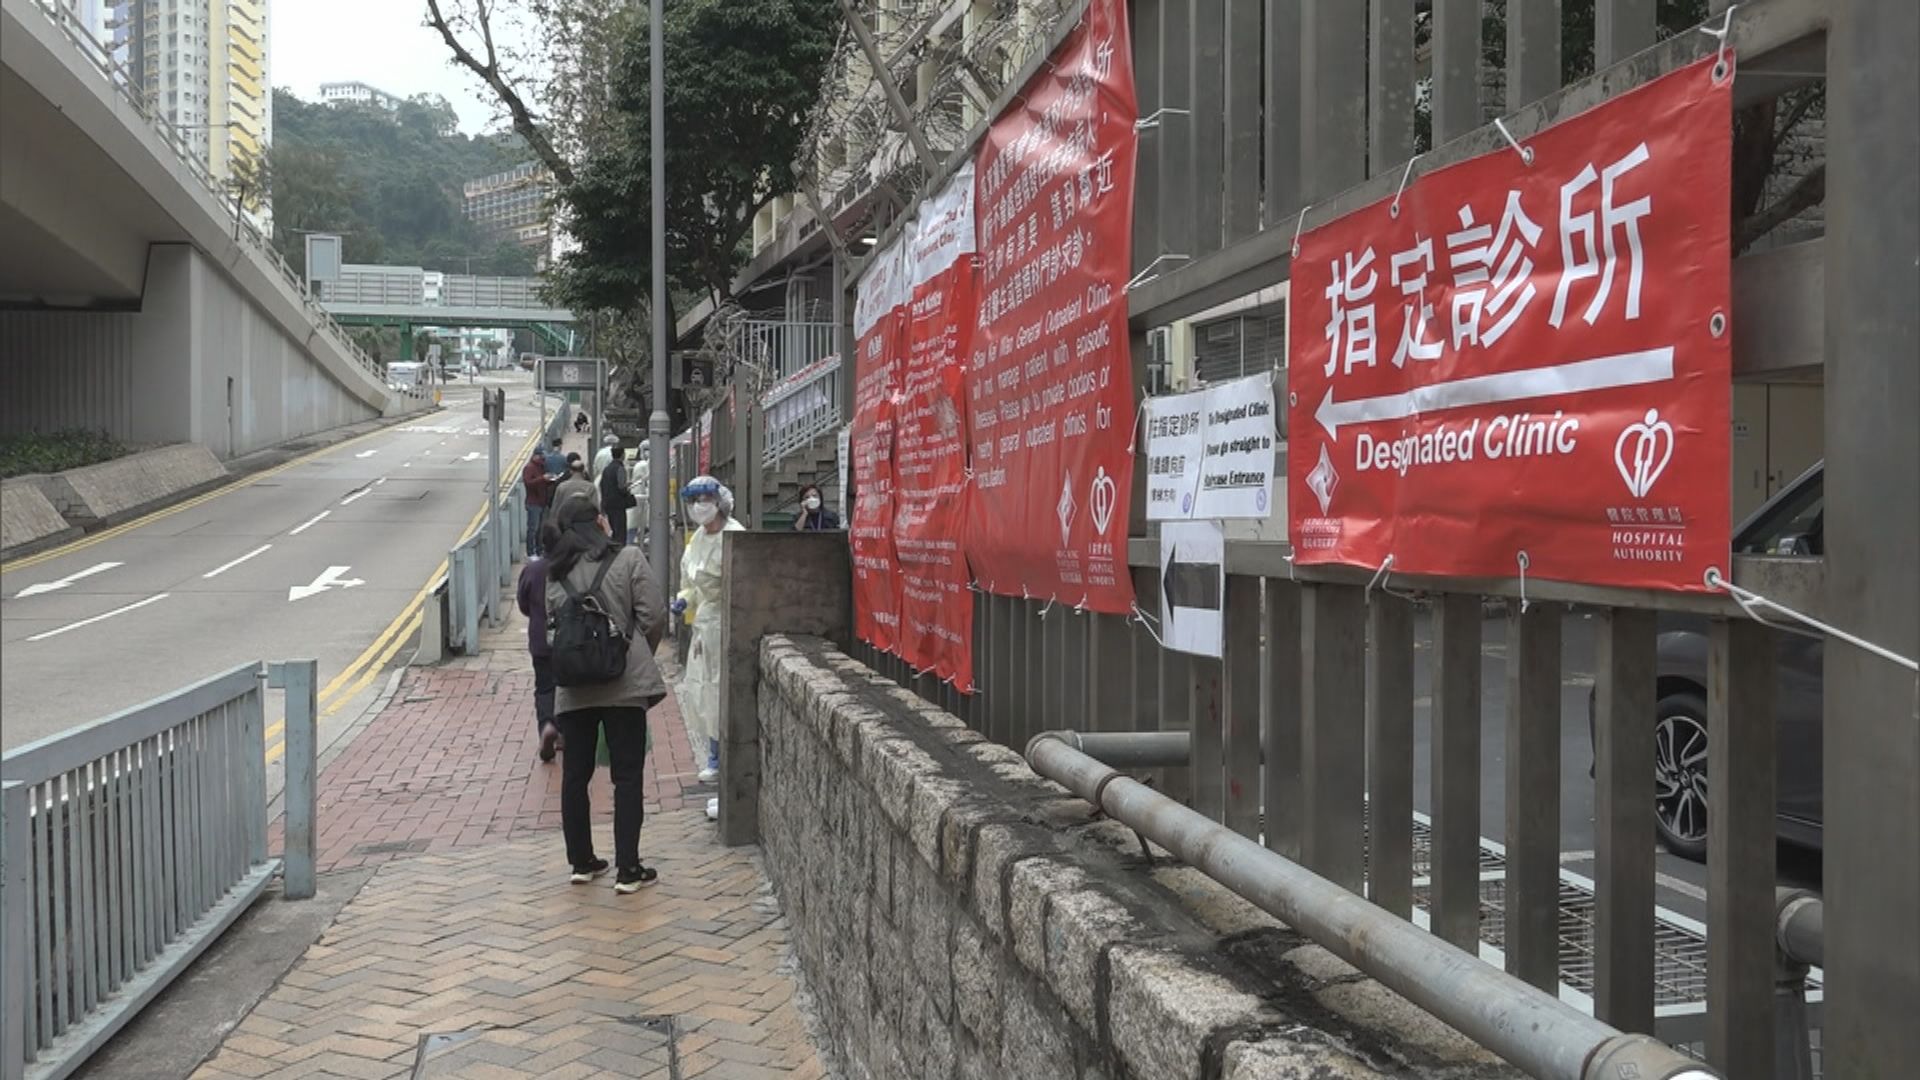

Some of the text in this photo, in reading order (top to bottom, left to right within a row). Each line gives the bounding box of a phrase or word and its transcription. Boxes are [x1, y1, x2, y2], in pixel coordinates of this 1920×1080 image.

[1325, 142, 1652, 377] 指定診所
[1016, 316, 1042, 349] General
[1086, 279, 1111, 313] Clinic
[1053, 338, 1070, 366] with
[1076, 320, 1110, 362] episodic
[1022, 397, 1031, 420] go
[1032, 390, 1041, 411] to
[1042, 380, 1065, 413] private
[1067, 370, 1096, 399] doctors
[1100, 365, 1110, 388] or
[1063, 409, 1087, 438] clinics
[1096, 401, 1112, 430] for
[1221, 440, 1228, 456] go
[1230, 436, 1260, 453] straight
[1262, 436, 1270, 449] to
[1356, 410, 1579, 476] Designated Clinic
[1229, 471, 1265, 485] Entrance
[1606, 507, 1682, 523] 醫院管理局
[1612, 531, 1685, 546] HOSPITAL
[1613, 548, 1683, 562] AUTHORITY
